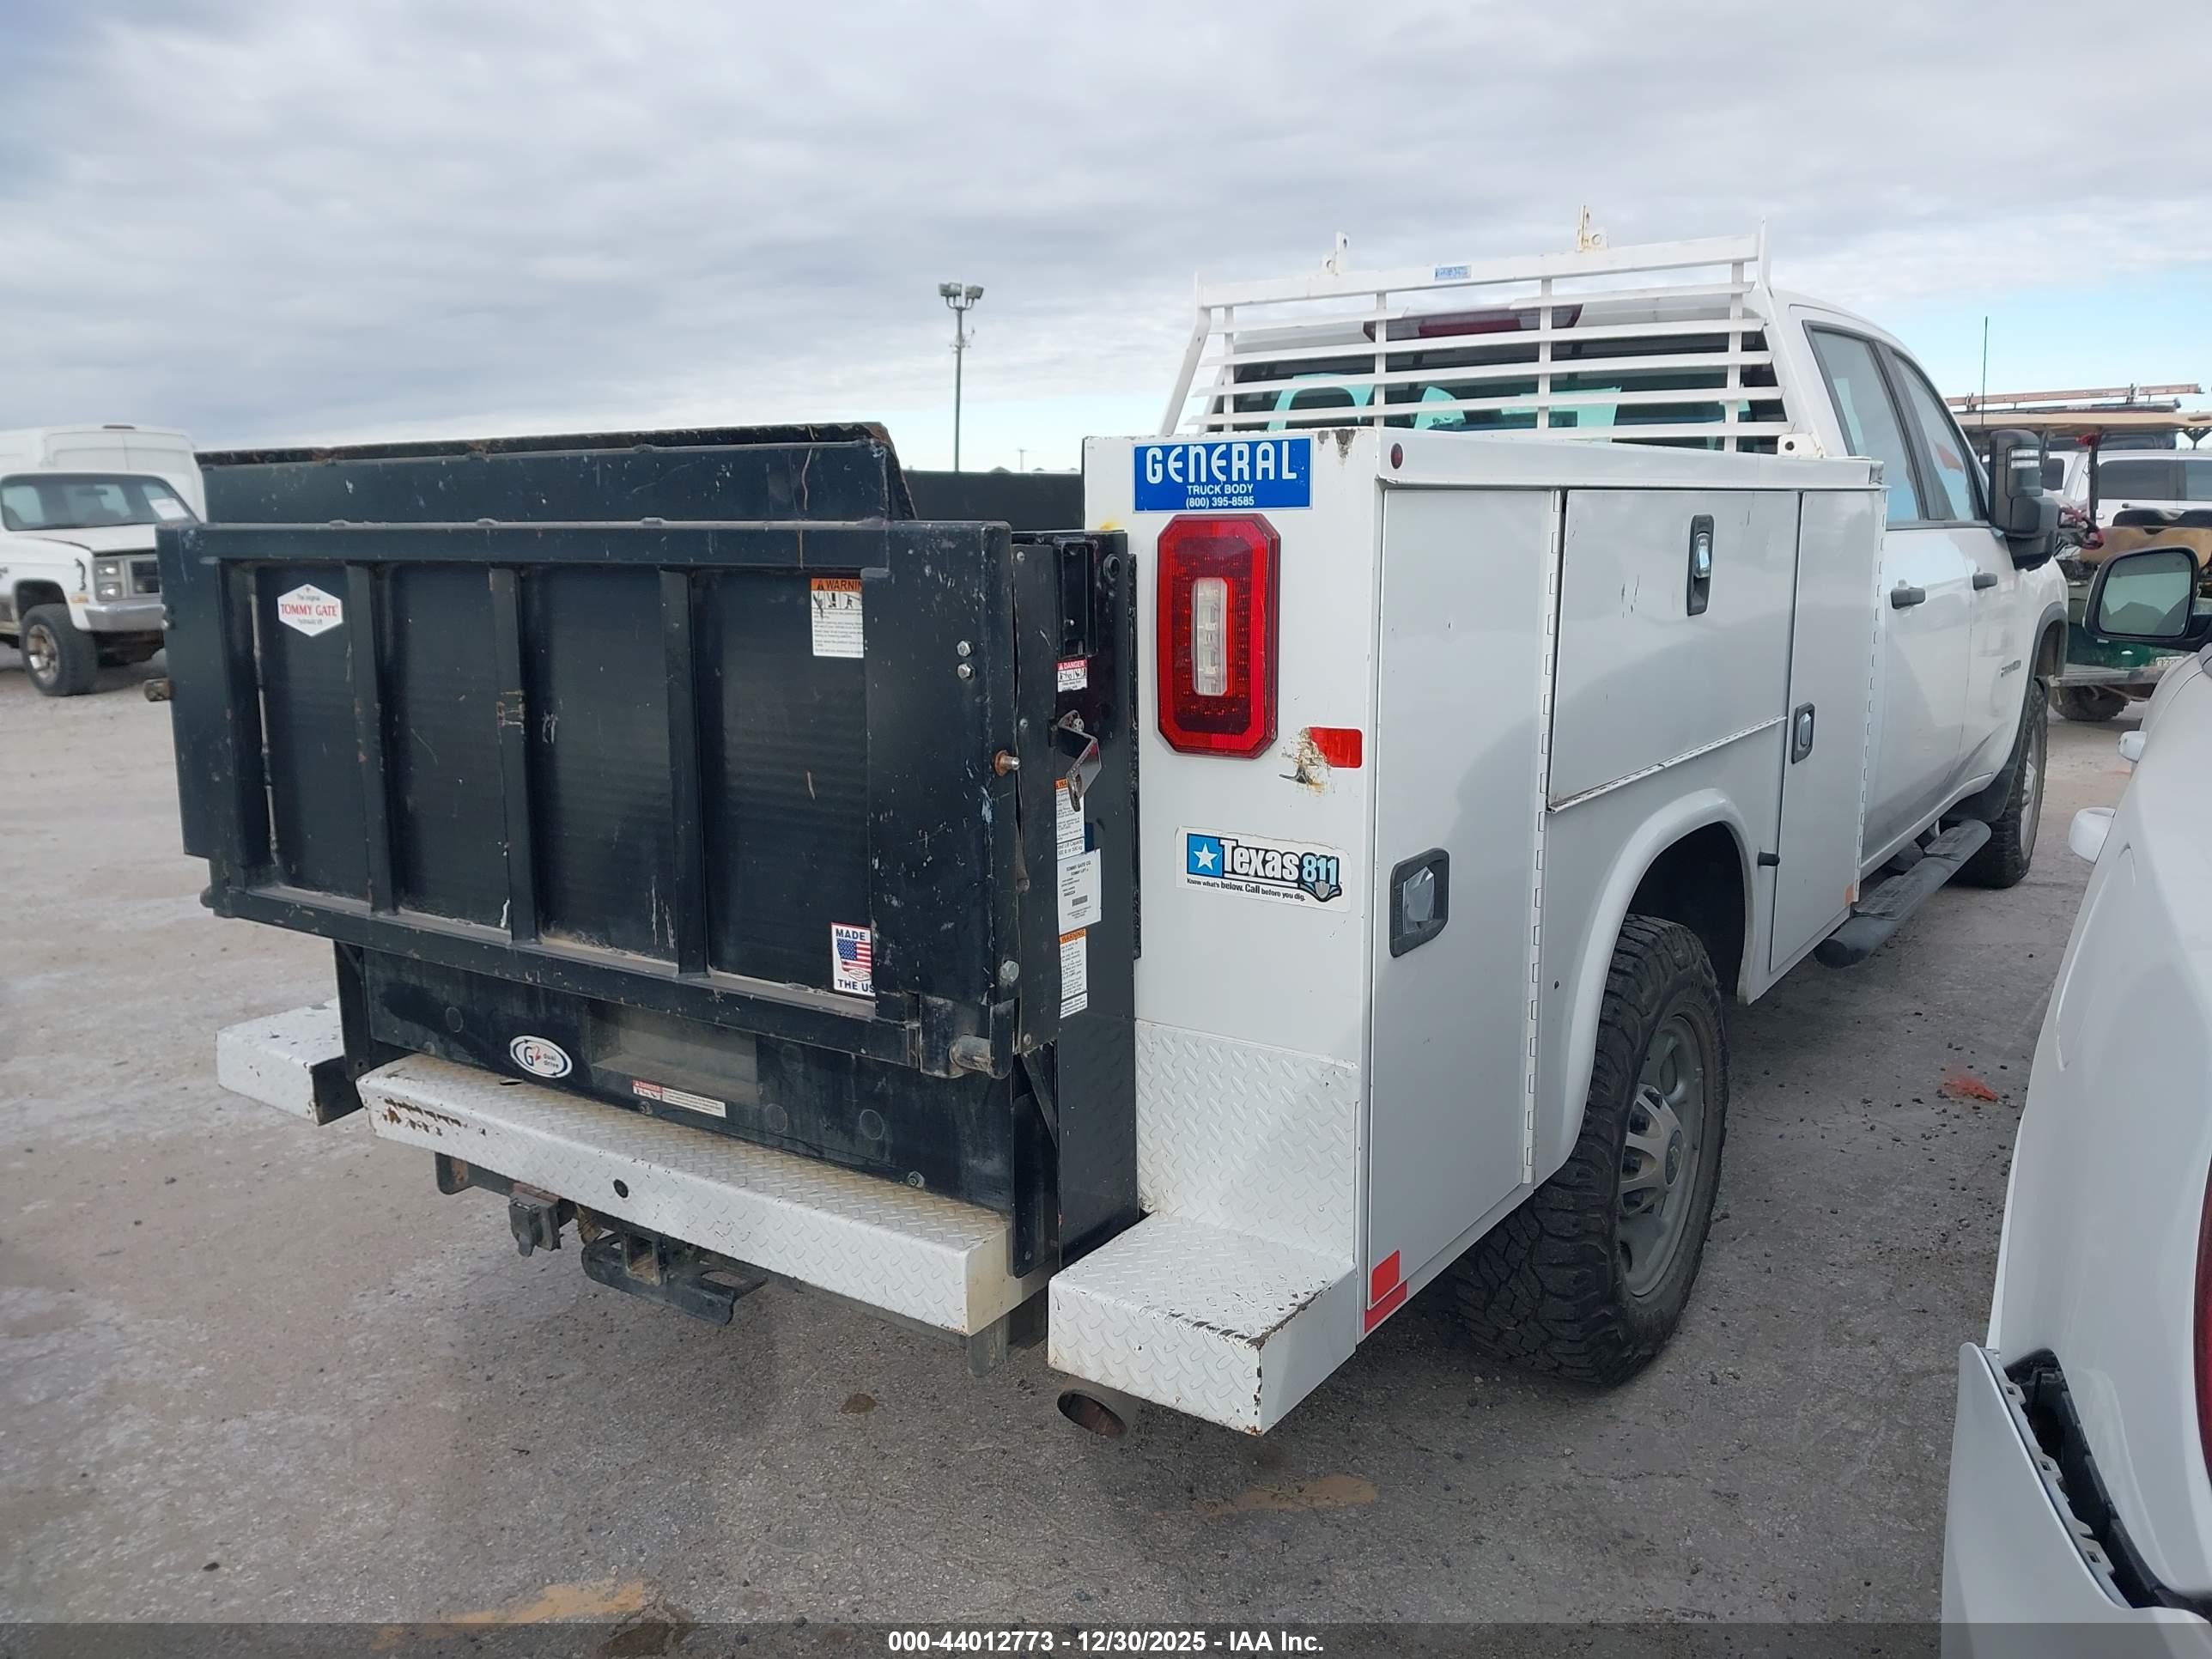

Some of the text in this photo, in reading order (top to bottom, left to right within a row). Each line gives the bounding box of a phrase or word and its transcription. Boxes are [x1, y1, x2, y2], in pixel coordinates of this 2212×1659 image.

[1146, 441, 1297, 484] GENERAL
[1186, 483, 1254, 495] TRUCK BODY
[1185, 495, 1255, 509] (800) 395-8585
[280, 604, 337, 617] TOMMY GATE
[1219, 838, 1338, 886] Texas 811
[1202, 879, 1220, 888] what's
[1220, 880, 1244, 892] below.
[1244, 884, 1261, 894] Call
[1261, 887, 1281, 897] before
[1282, 890, 1294, 899] you
[1294, 892, 1306, 902] dig.
[836, 928, 866, 941] MADE
[1061, 929, 1085, 943] WARNING
[838, 978, 858, 990] THE
